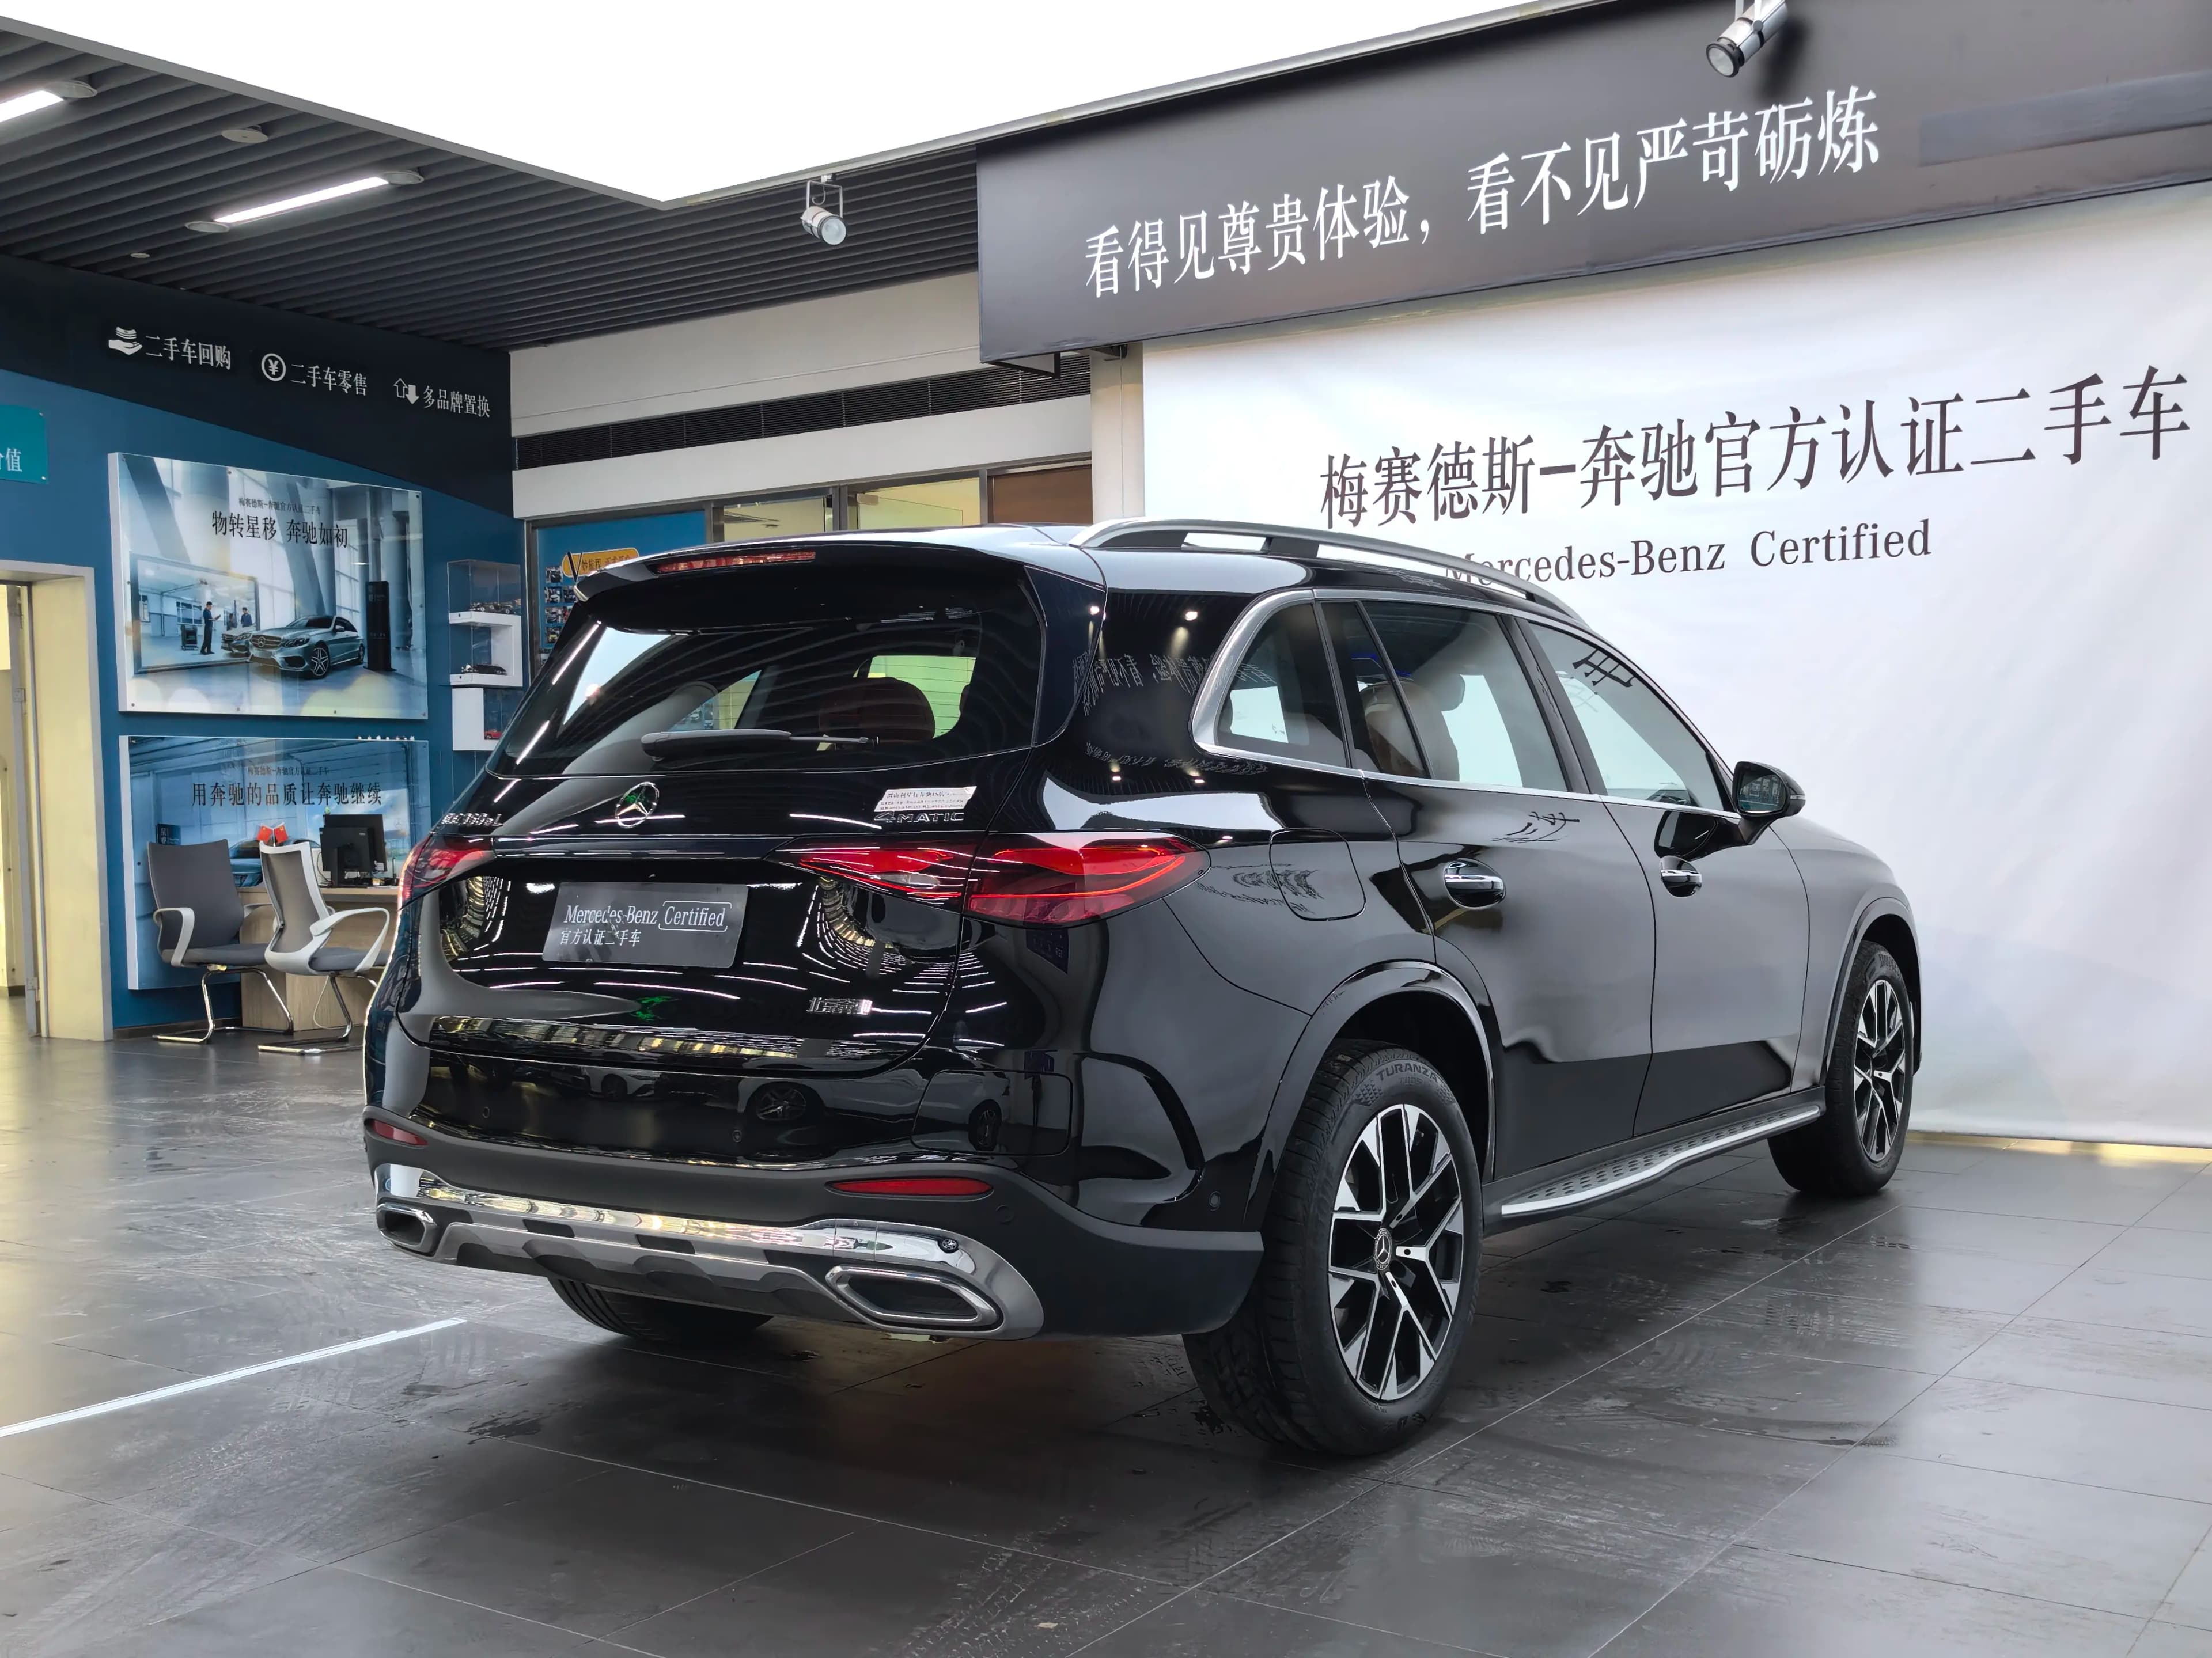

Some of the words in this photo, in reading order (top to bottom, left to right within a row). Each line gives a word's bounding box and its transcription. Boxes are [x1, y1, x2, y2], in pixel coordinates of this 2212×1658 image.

[145, 335, 230, 370] 二手车回购
[291, 363, 367, 396] 二手车零售
[422, 385, 491, 418] 多品牌置换
[211, 511, 277, 541] 物转星移
[286, 519, 348, 548] 奔驰如初
[1751, 518, 1931, 567] Certified
[192, 781, 382, 806] 用奔驰的品质让奔驰继续
[873, 810, 965, 823] 4MATIC
[563, 905, 659, 925] Mercedes-Benz
[664, 906, 726, 927] Certified
[560, 928, 641, 947] 官方认证二手车
[1376, 1063, 1438, 1083] TURANZA
